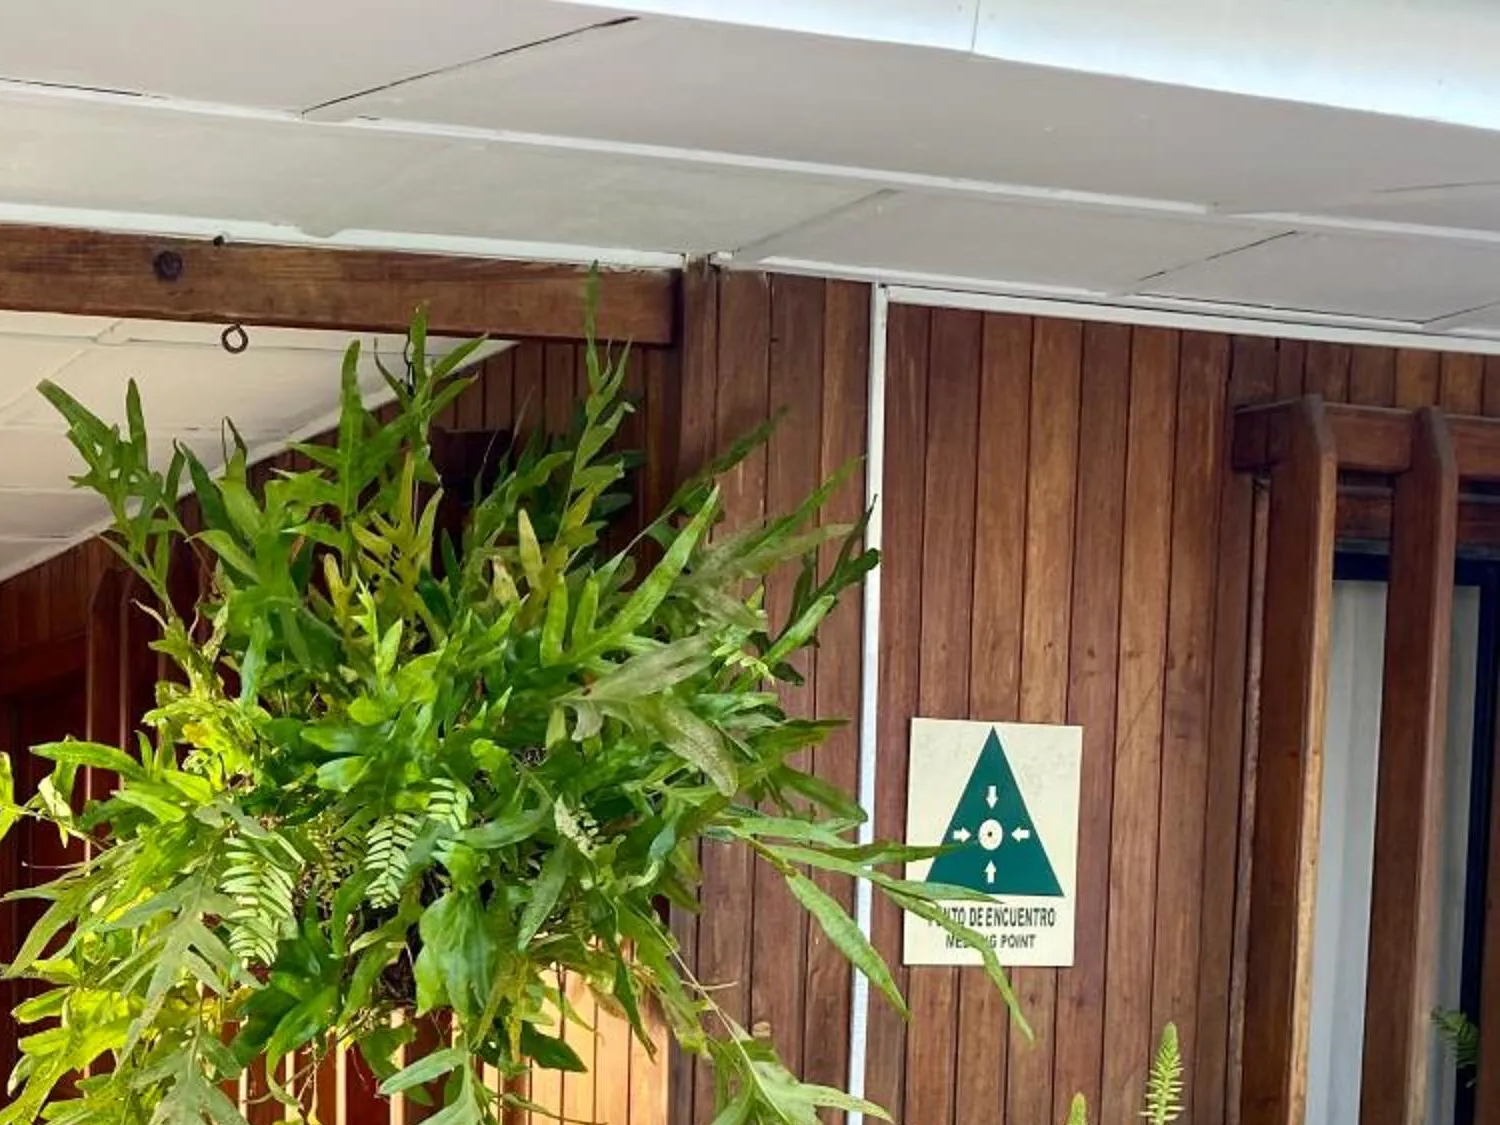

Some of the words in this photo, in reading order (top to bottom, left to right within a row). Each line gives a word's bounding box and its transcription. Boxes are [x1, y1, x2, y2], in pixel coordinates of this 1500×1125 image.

[969, 907, 984, 927] DE
[985, 907, 1056, 927] ENCUENTRO
[1001, 934, 1036, 949] POINT
